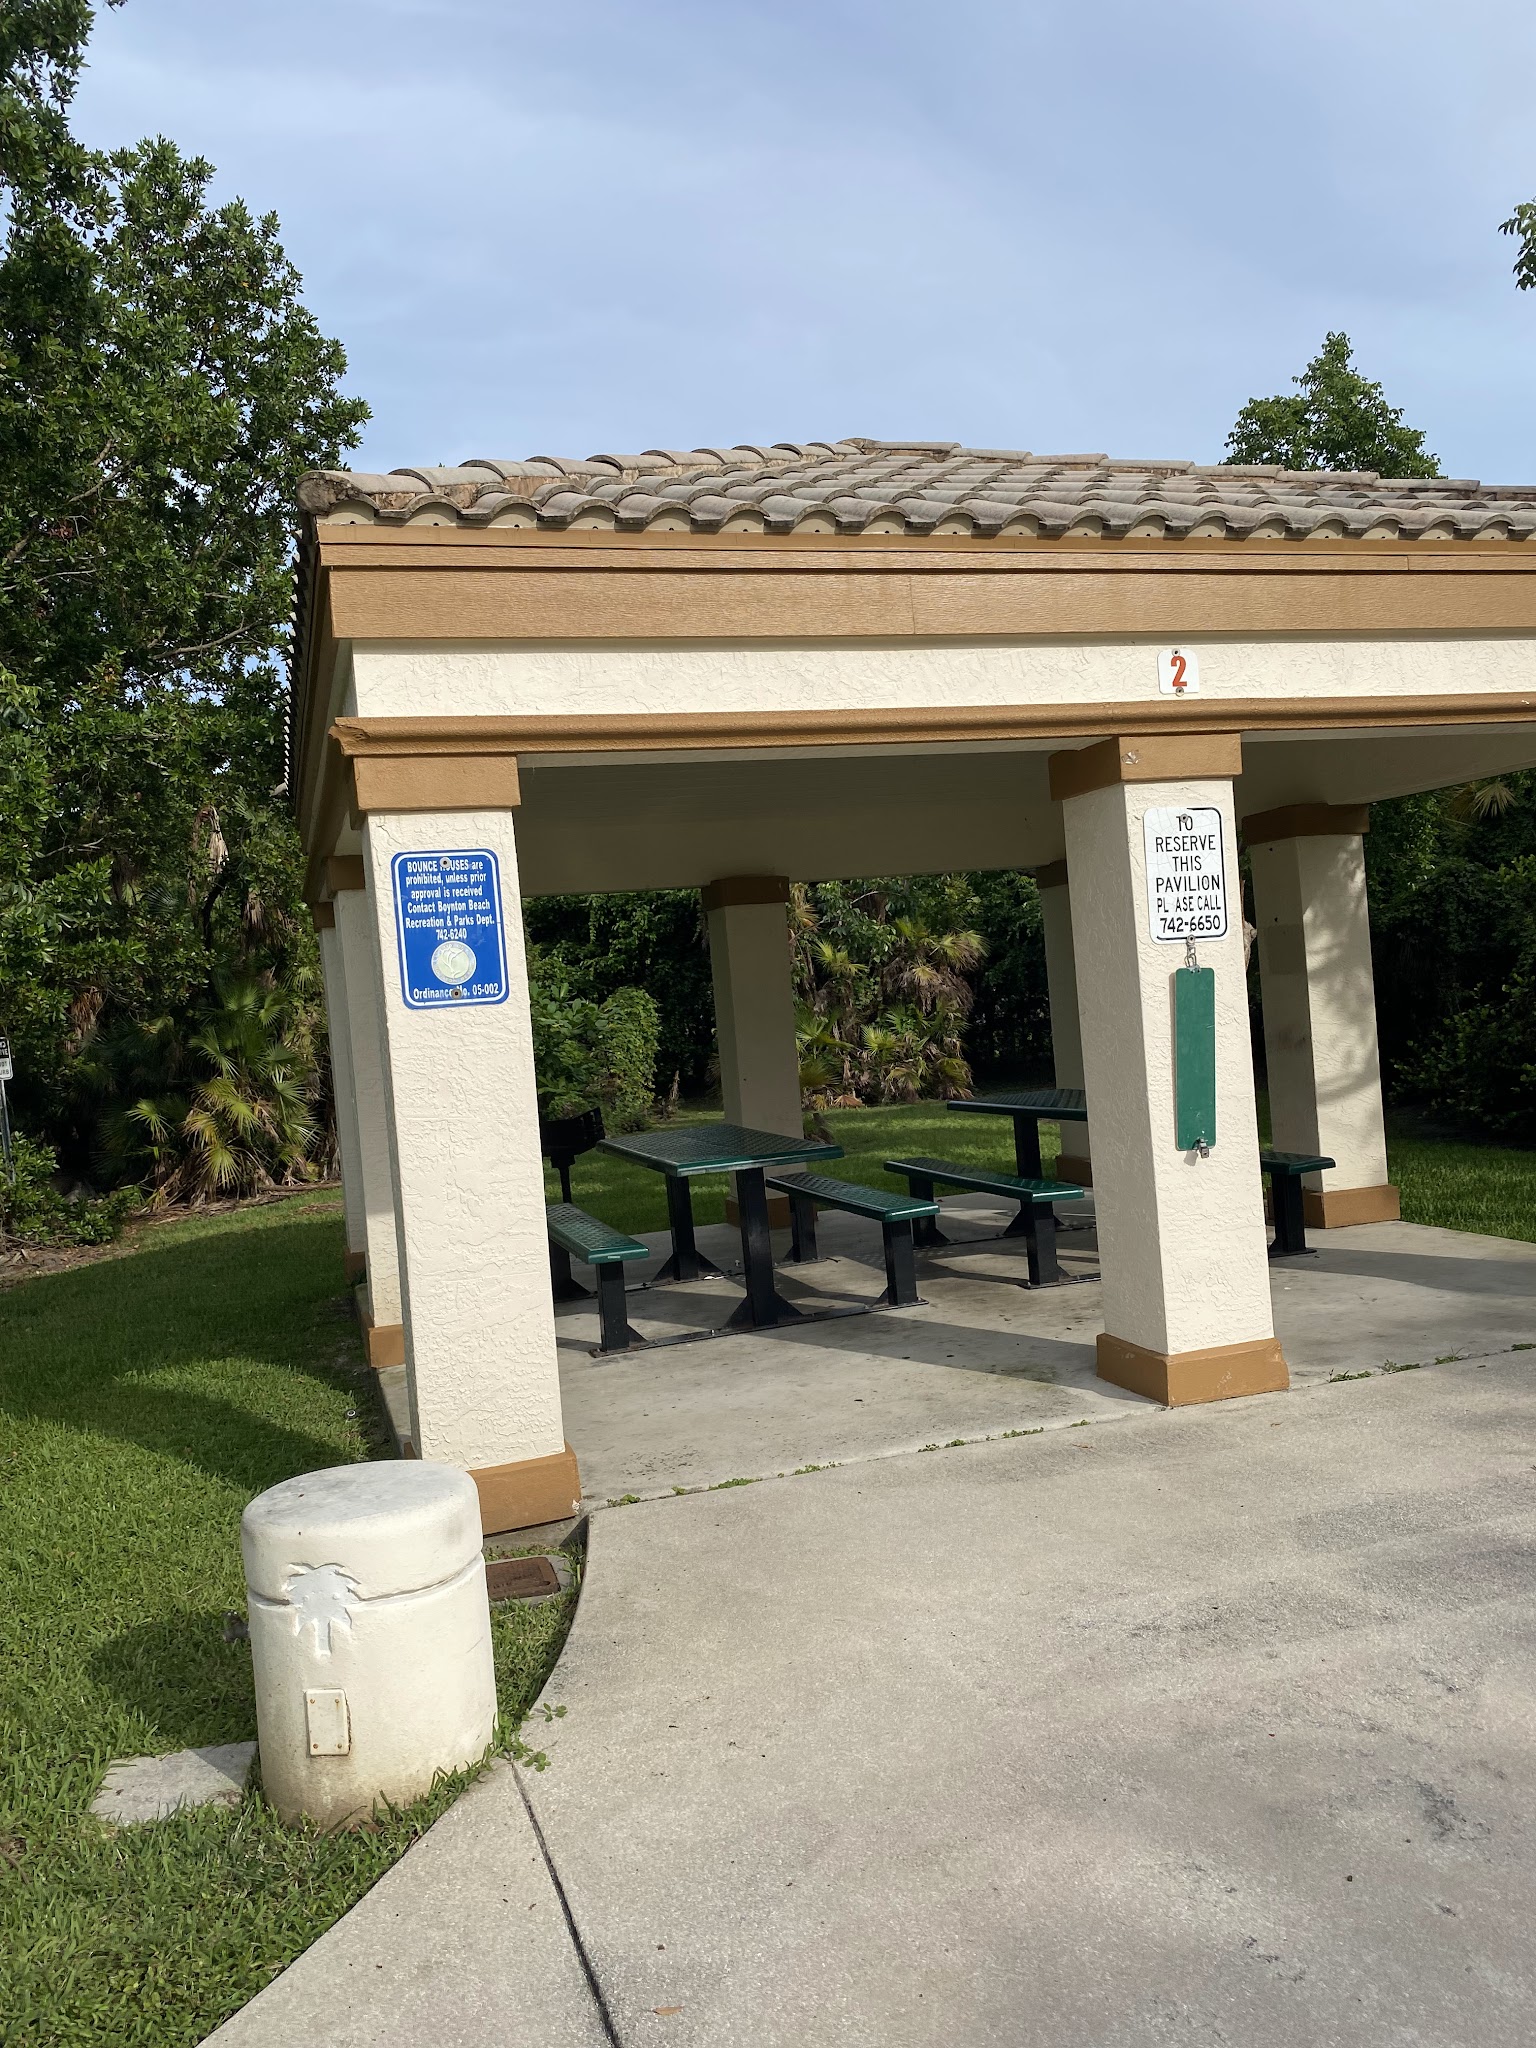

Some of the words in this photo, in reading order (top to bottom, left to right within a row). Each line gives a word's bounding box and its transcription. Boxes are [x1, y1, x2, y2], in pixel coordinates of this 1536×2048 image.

[1171, 656, 1187, 687] 2
[1176, 815, 1193, 832] TO
[1155, 834, 1216, 853] RESERVE
[407, 861, 438, 873] BOUNCE
[440, 859, 469, 871] USES
[471, 861, 484, 870] are
[1172, 855, 1202, 872] THIS
[405, 873, 444, 888] prohibited,
[445, 872, 468, 884] unless
[470, 871, 487, 885] prior
[1156, 874, 1220, 893] PAVILION
[411, 887, 442, 902] approval
[443, 886, 451, 898] is
[452, 885, 483, 898] received
[407, 901, 436, 914] Contact
[437, 900, 467, 915] Boynton
[468, 898, 491, 911] Beach
[1156, 896, 1195, 914] PLASE
[1197, 895, 1221, 911] CALL
[405, 916, 445, 929] Recreation
[446, 914, 452, 927] &
[453, 914, 475, 927] Parks
[476, 913, 495, 928] Dept.
[1160, 915, 1221, 934] 742-6650
[436, 928, 467, 941] 742-6240
[472, 982, 499, 996] 05-002
